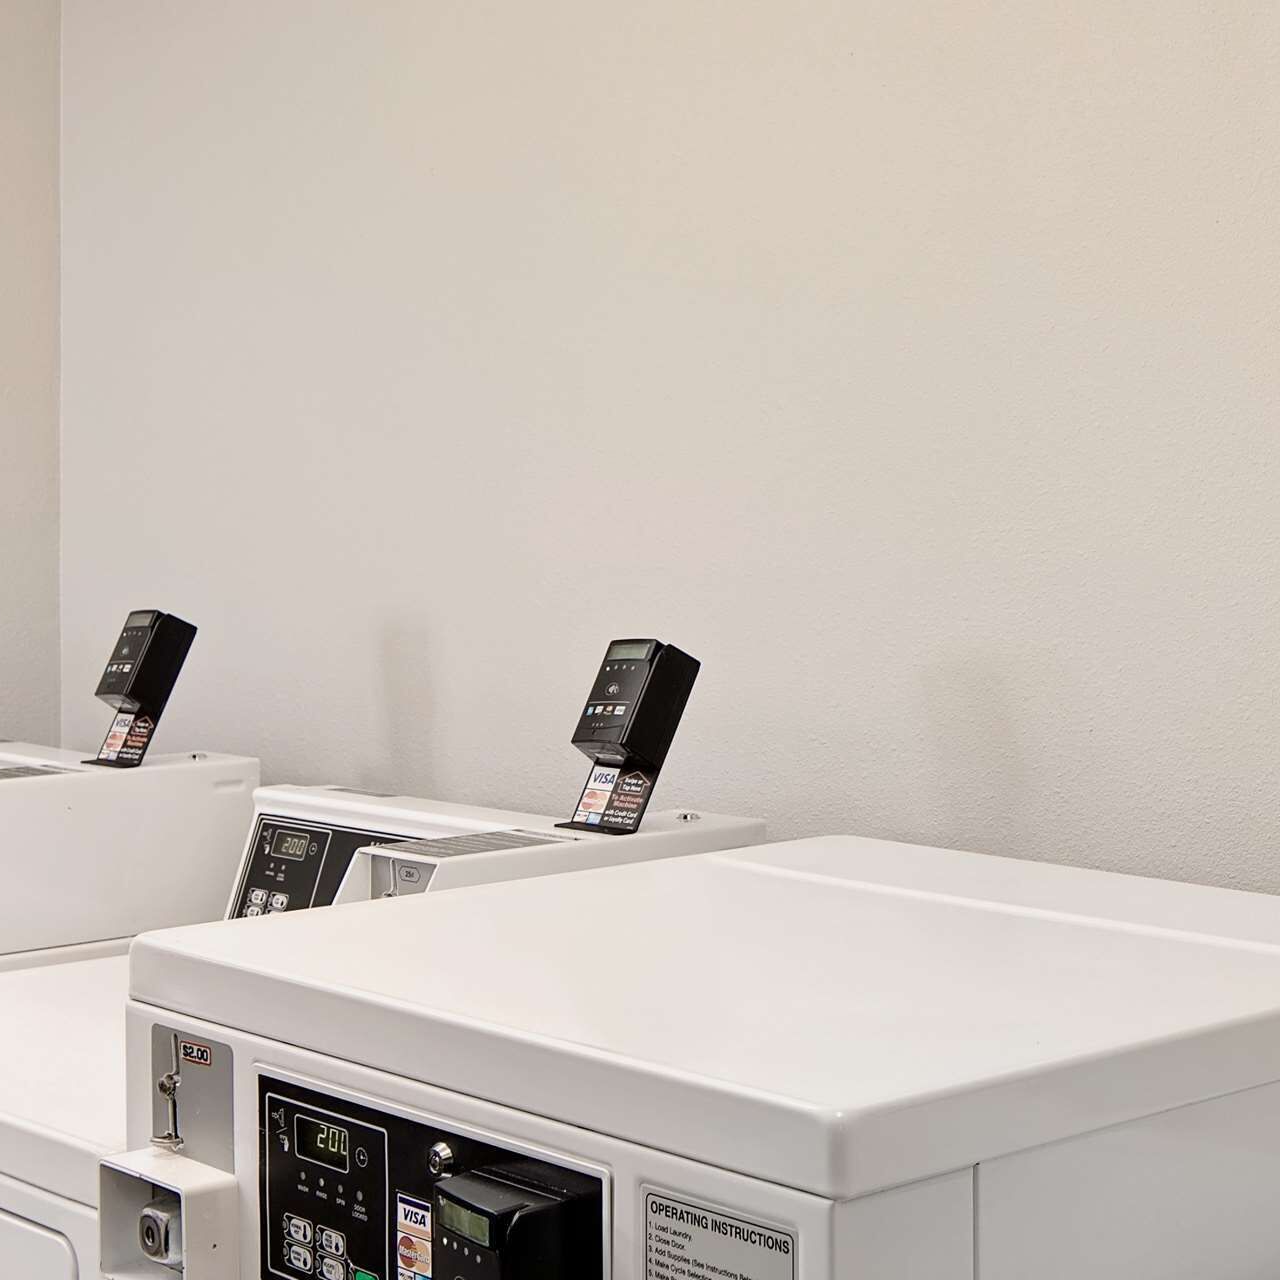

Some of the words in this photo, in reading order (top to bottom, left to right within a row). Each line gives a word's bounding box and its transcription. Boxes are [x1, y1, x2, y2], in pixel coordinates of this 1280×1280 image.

[593, 772, 615, 785] VISA
[282, 838, 305, 854] 200
[183, 1045, 208, 1062] $2.00
[403, 1208, 427, 1227] VISA
[649, 1221, 654, 1229] 1.
[655, 1223, 668, 1234] Load
[650, 1201, 708, 1229] OPERATING
[711, 1219, 790, 1254] INSTRUCTIONS
[648, 1233, 654, 1241] 2.
[655, 1235, 670, 1246] Close
[648, 1245, 654, 1253] 3.
[655, 1247, 666, 1257] Add
[667, 1250, 690, 1265] Supplies
[692, 1258, 704, 1270] (See
[706, 1262, 738, 1280] Instructions
[648, 1257, 654, 1265] 4.
[655, 1260, 669, 1270] Make
[670, 1264, 685, 1276] Cycle
[648, 1269, 654, 1277] 5.
